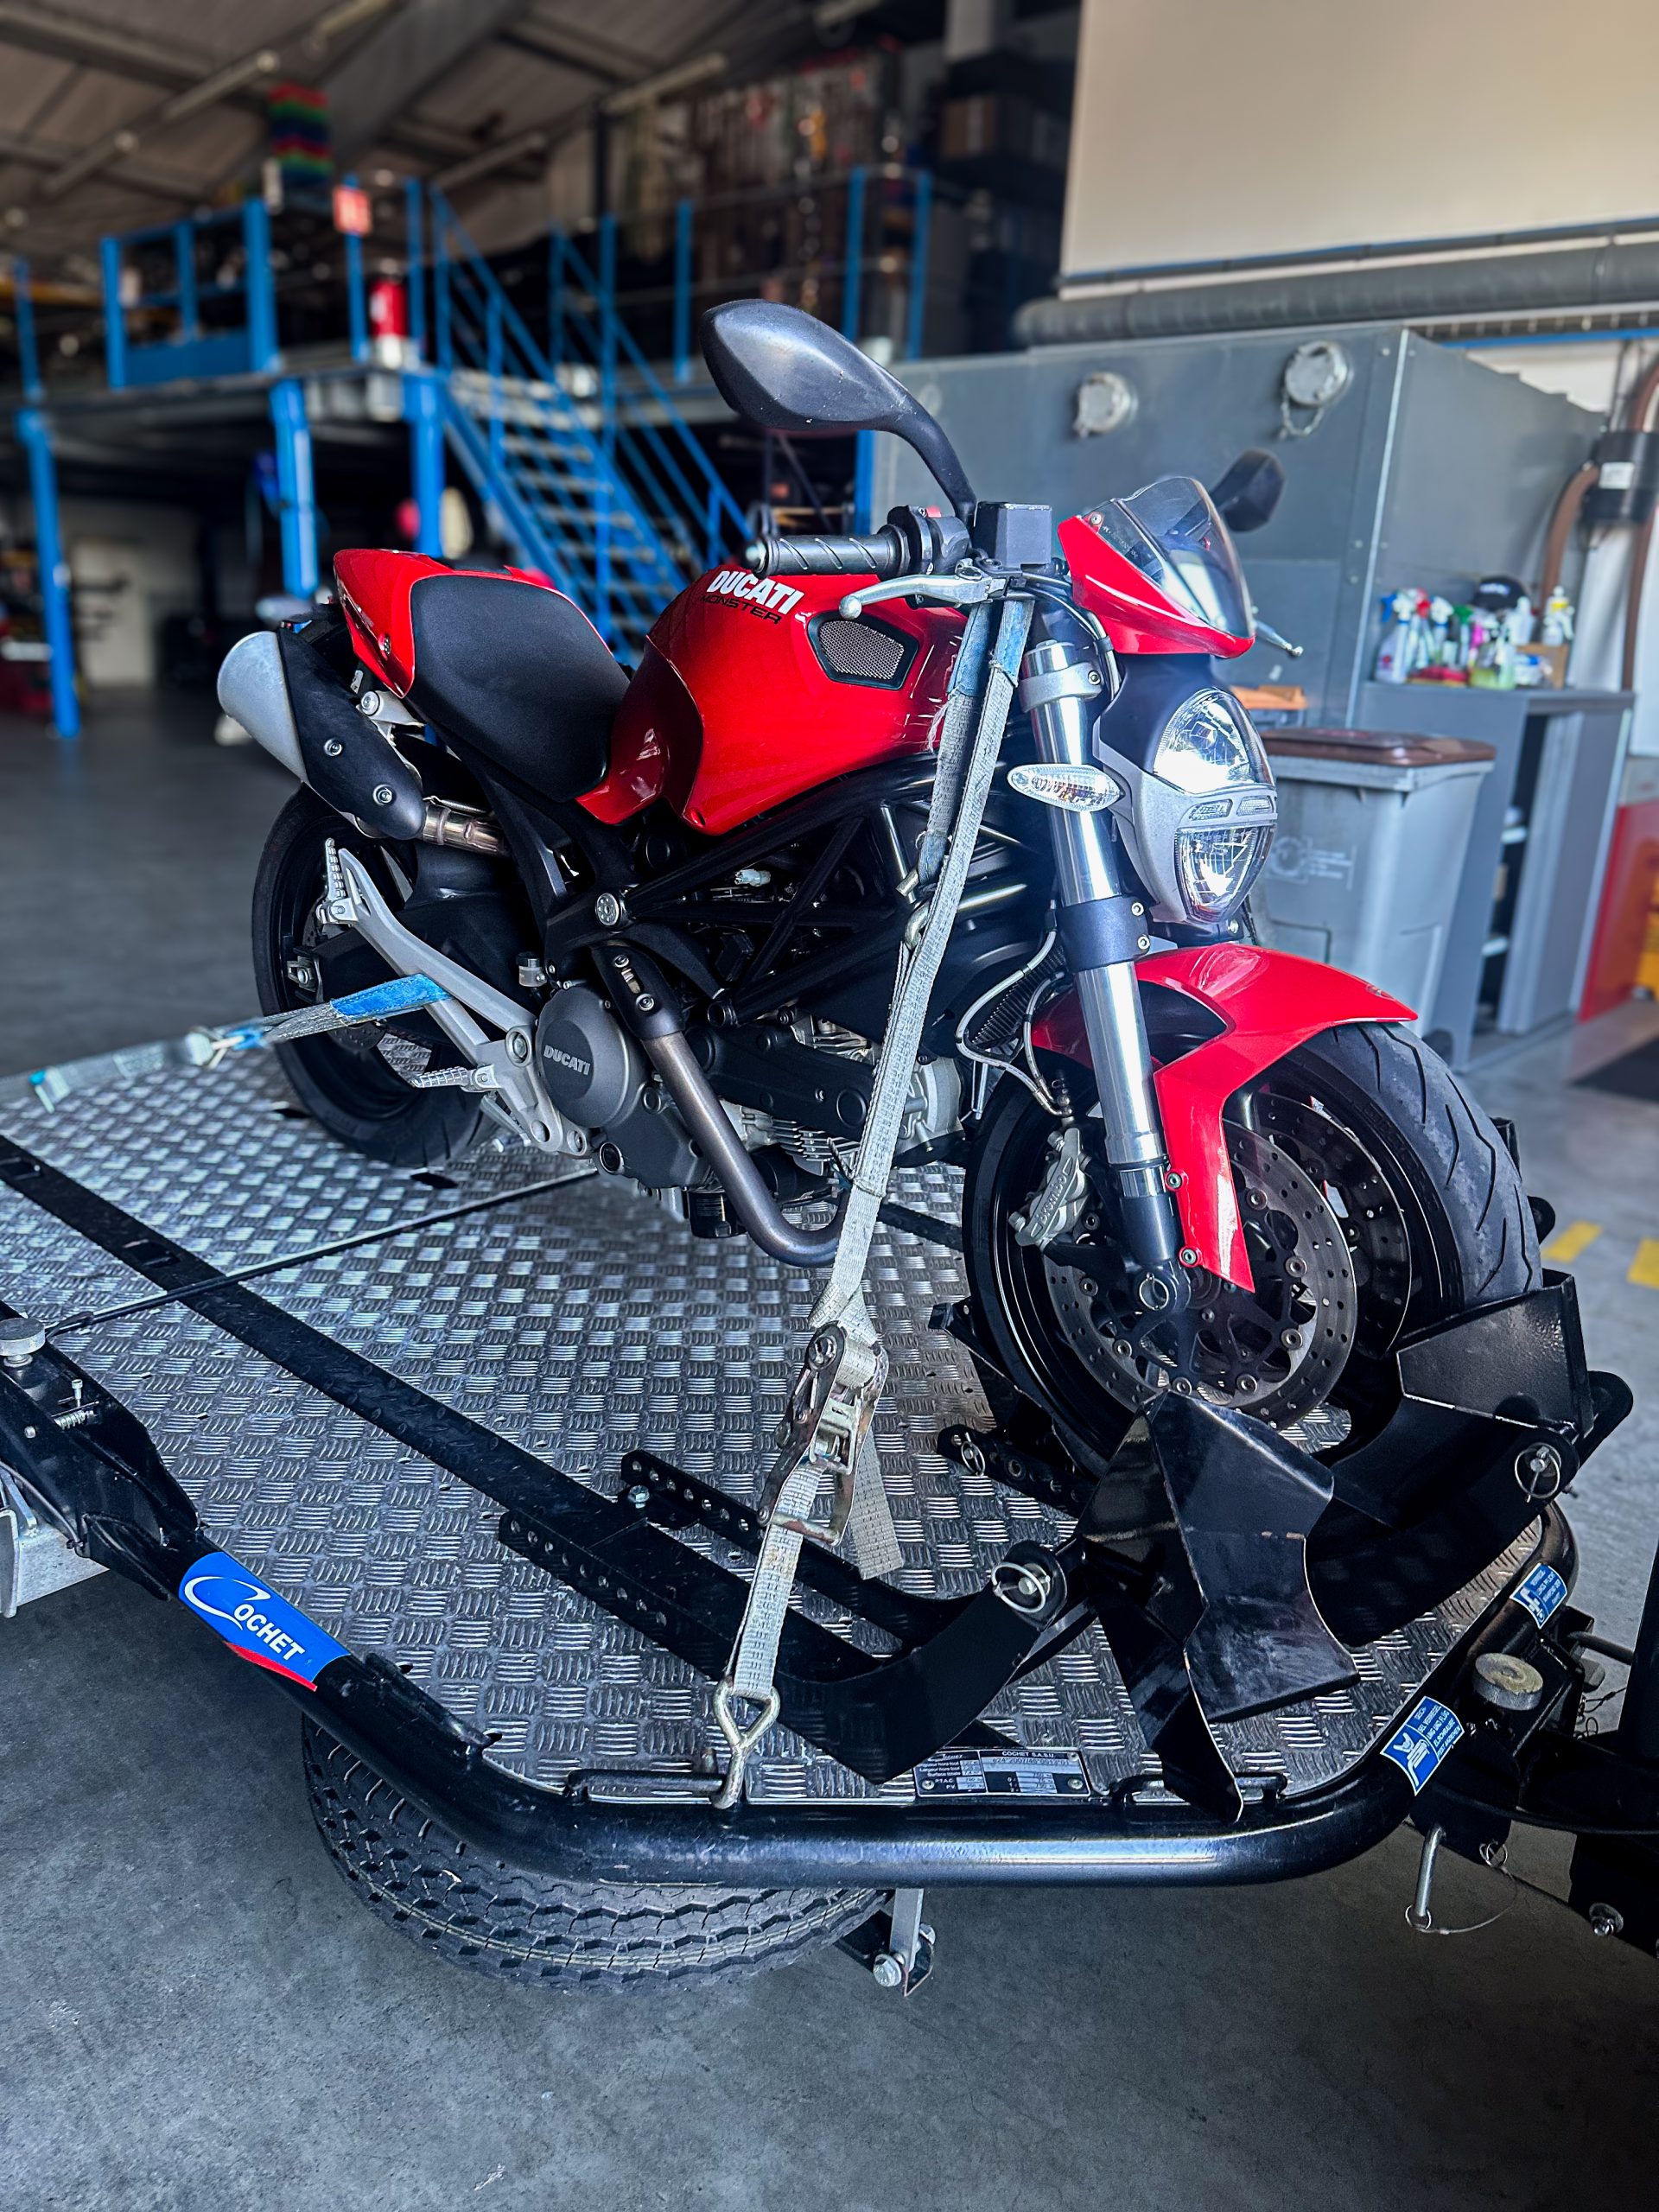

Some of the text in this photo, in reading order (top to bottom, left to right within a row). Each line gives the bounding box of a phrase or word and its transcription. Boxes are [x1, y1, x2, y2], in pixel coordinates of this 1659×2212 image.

[700, 594, 782, 624] MONSTER
[706, 570, 804, 614] DUCATI
[543, 1045, 591, 1076] DUCATI
[184, 1575, 306, 1661] COCHET
